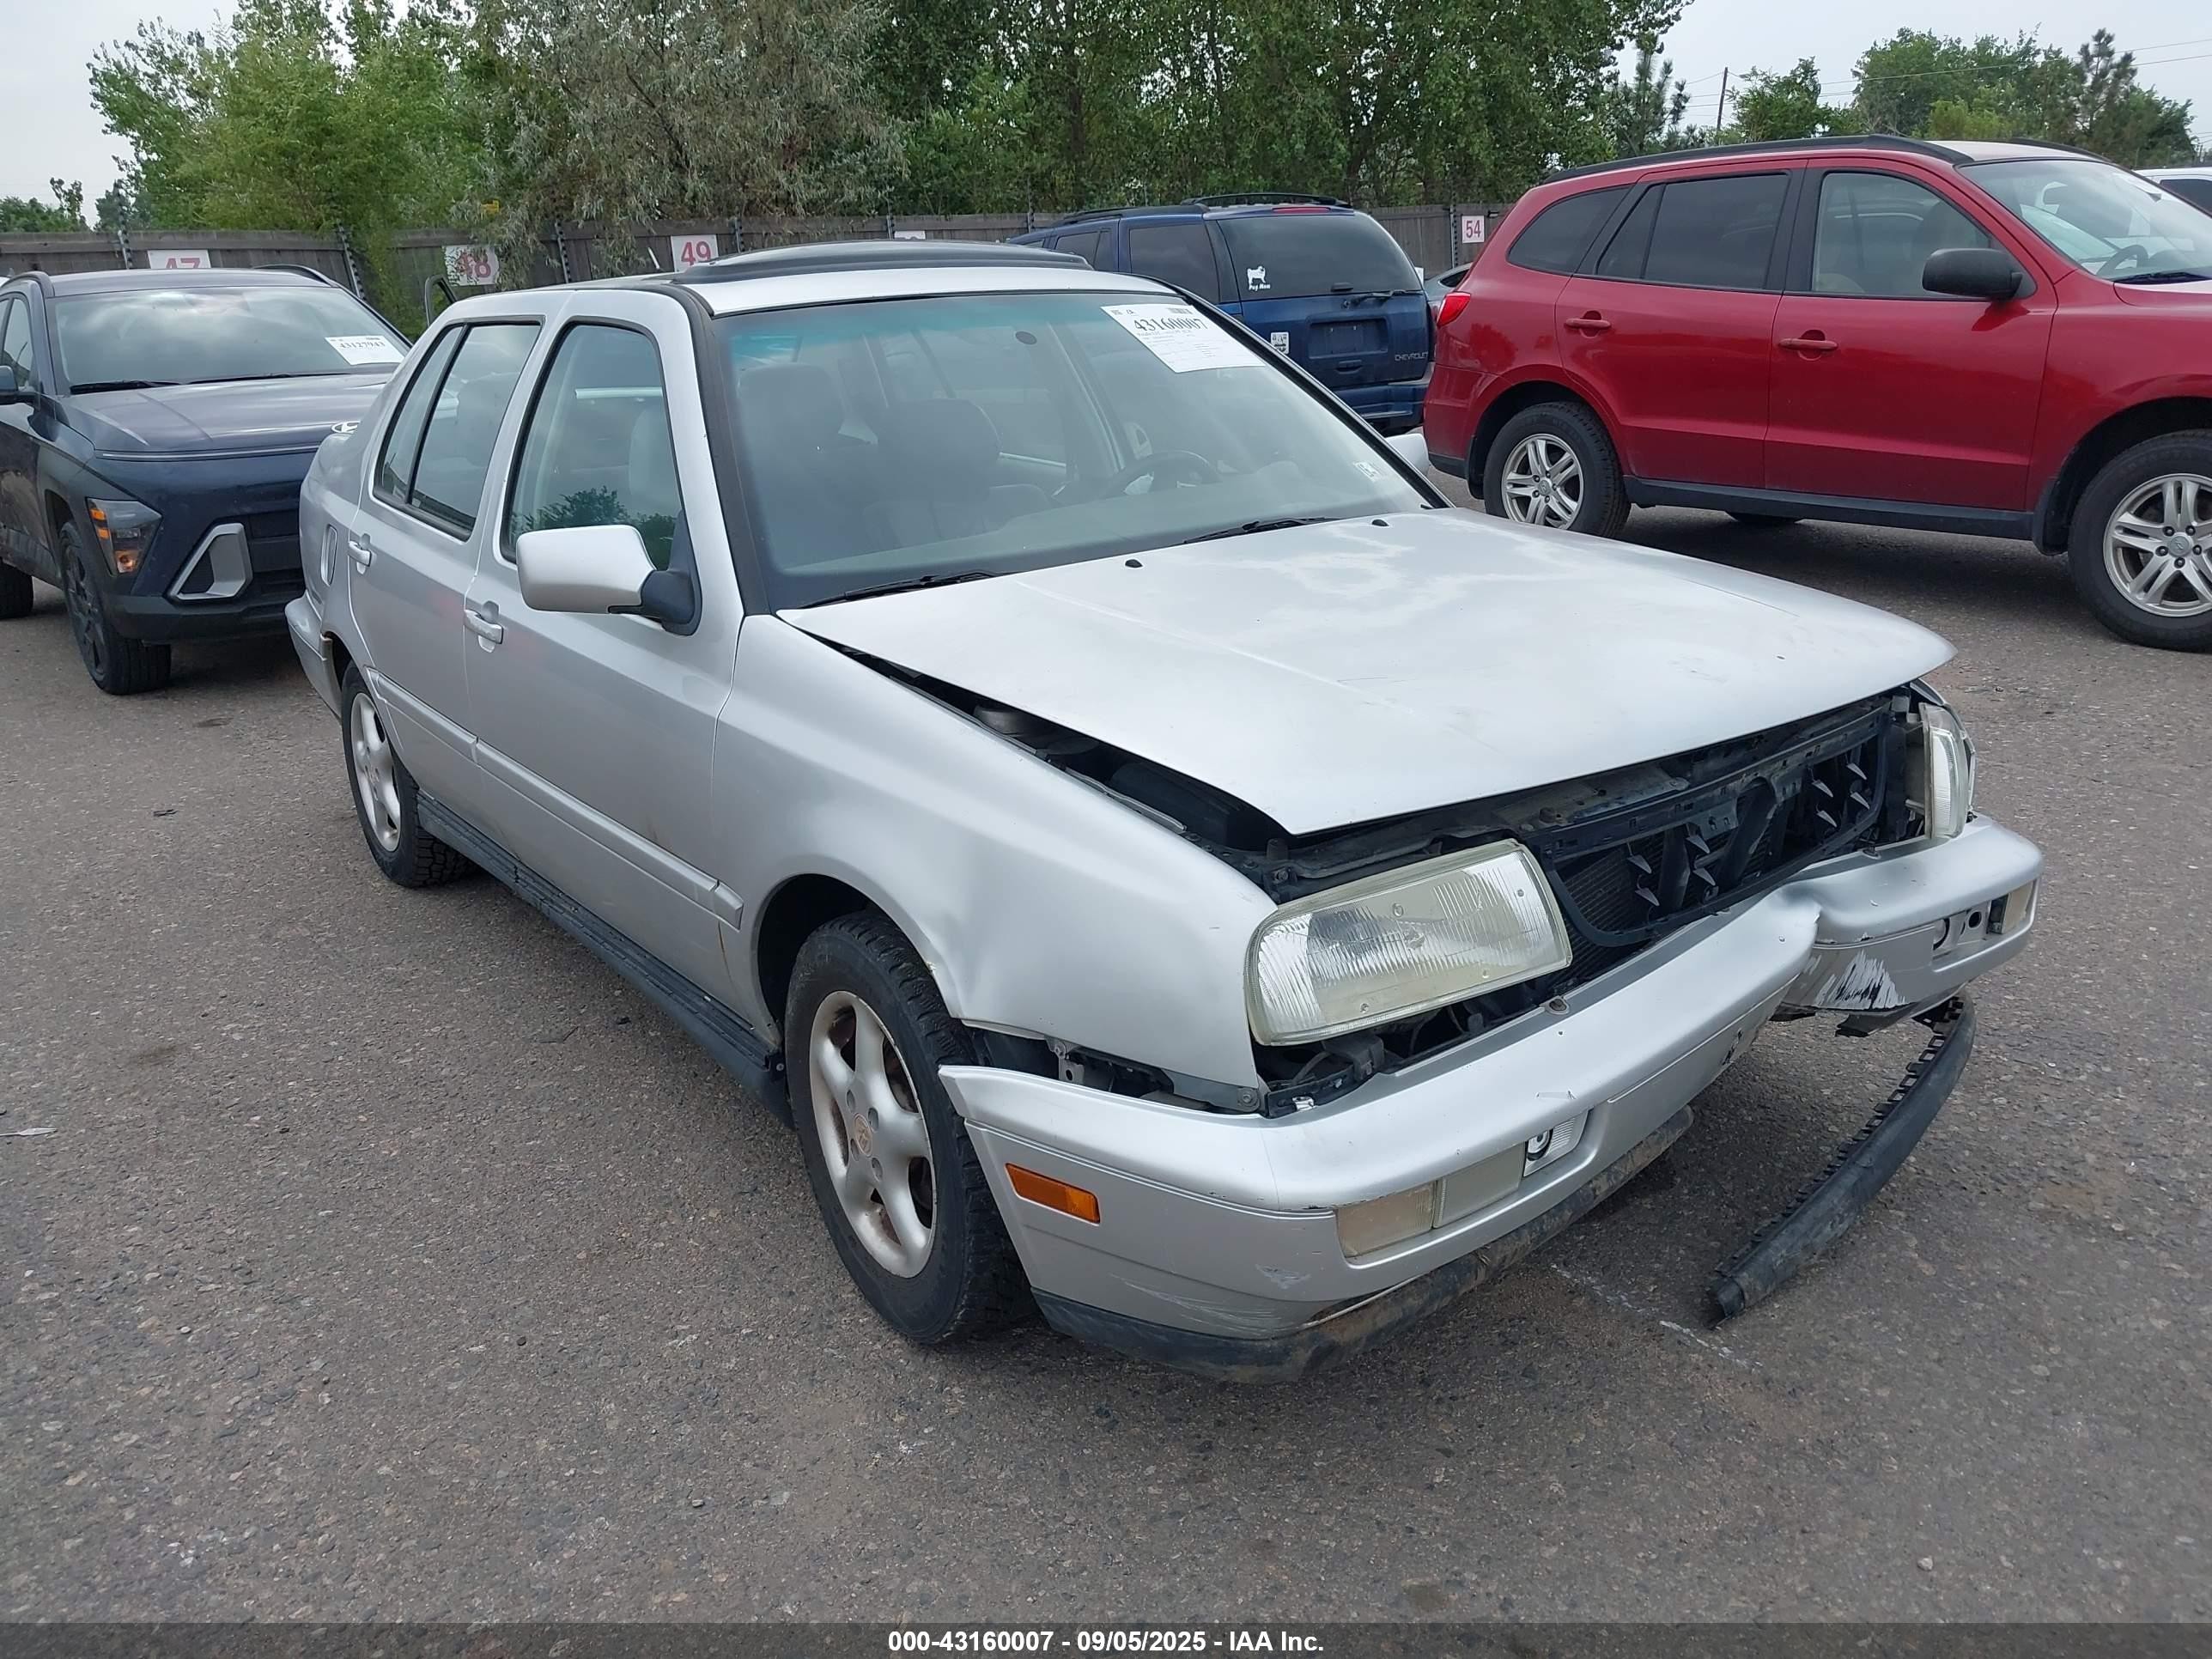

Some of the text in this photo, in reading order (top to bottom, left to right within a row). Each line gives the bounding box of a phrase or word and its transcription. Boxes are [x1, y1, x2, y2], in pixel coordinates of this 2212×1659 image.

[1466, 219, 1481, 239] 54
[681, 240, 712, 266] 49
[1133, 317, 1208, 331] 43160007
